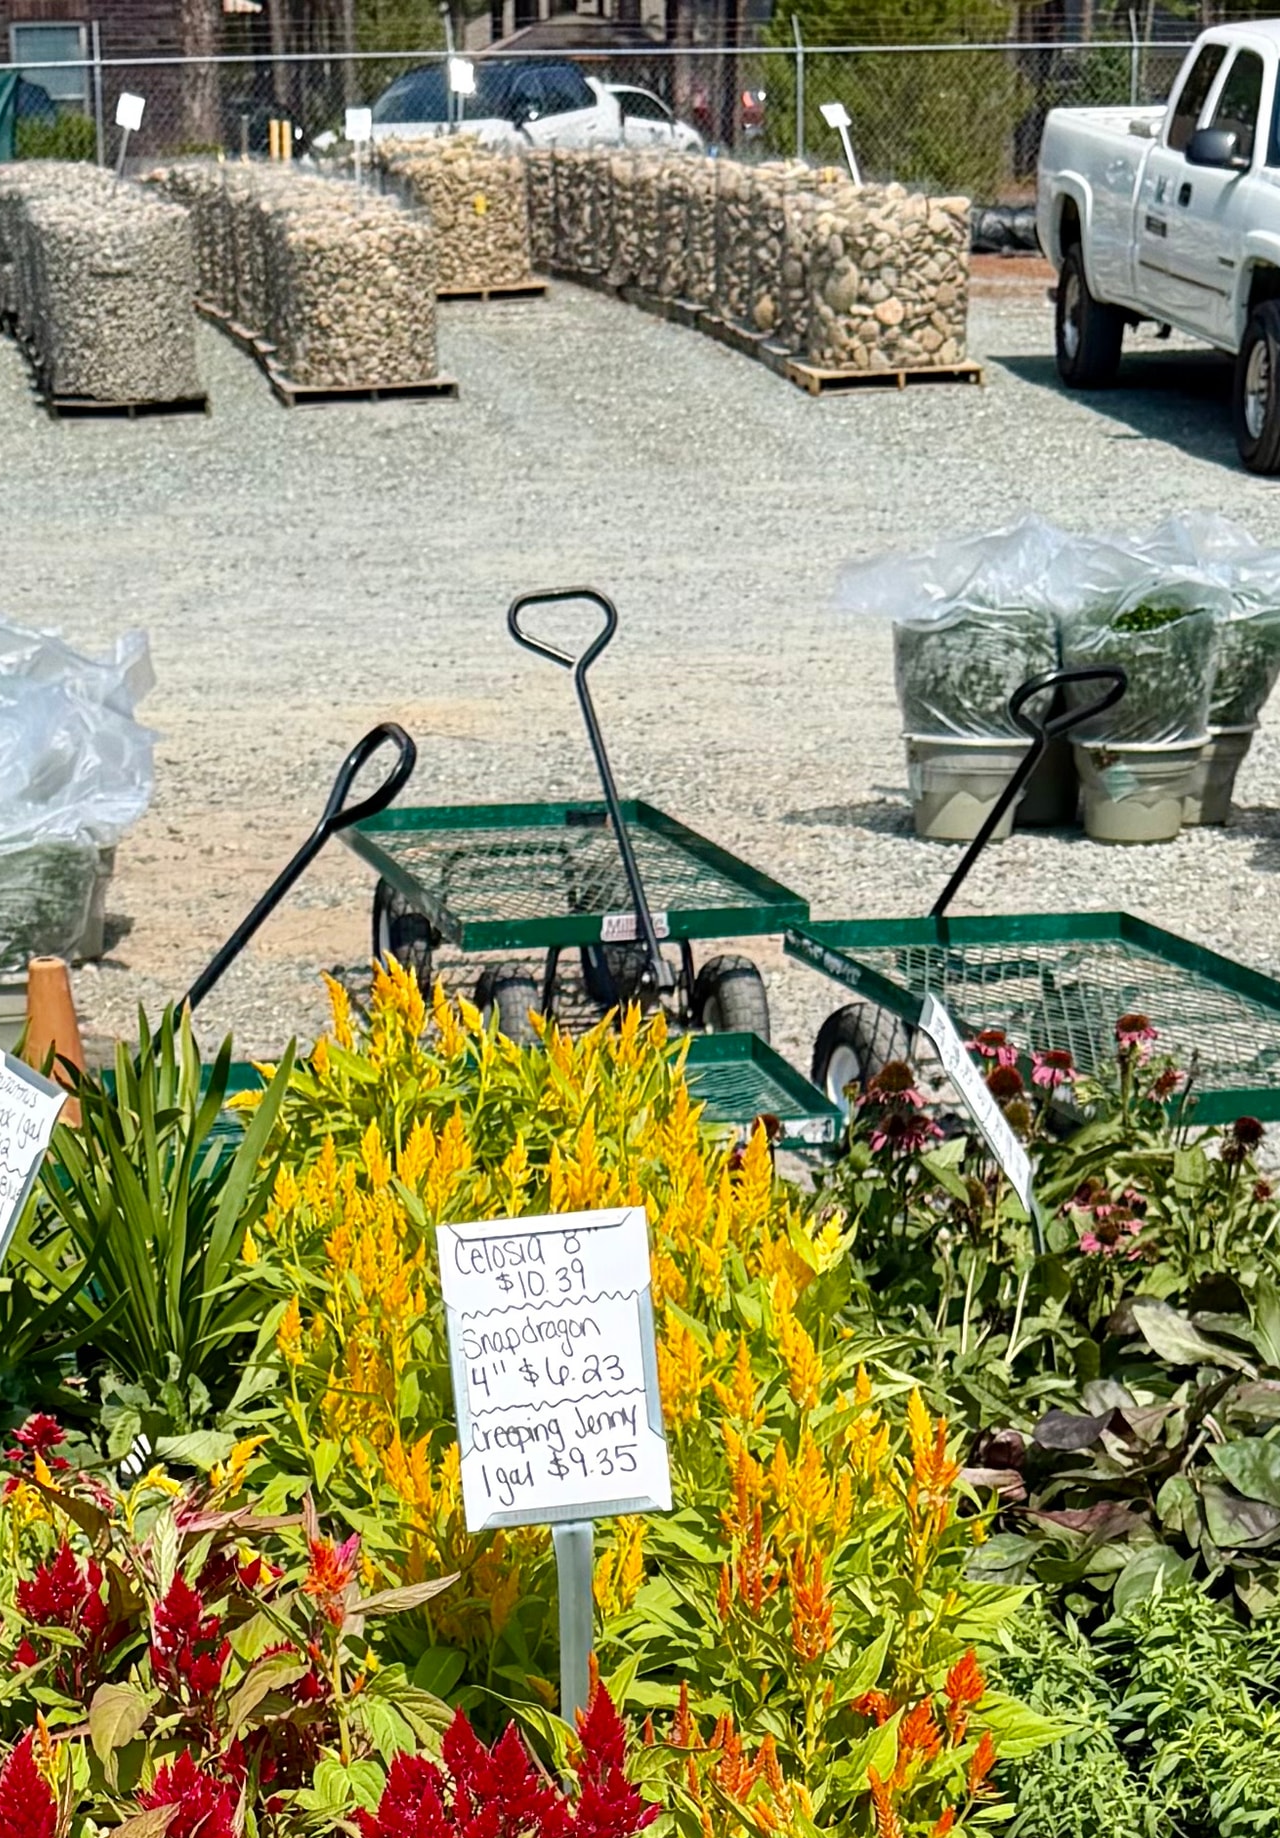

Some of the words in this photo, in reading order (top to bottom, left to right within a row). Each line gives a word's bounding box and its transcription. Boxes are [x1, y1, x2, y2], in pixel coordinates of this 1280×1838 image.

[455, 1234, 546, 1275] Celosia
[496, 1258, 587, 1299] $10.39
[462, 1316, 601, 1360] Snapdragon
[471, 1417, 566, 1454] Creeping
[575, 1404, 638, 1440] Jenny
[547, 1443, 639, 1481] $9.35
